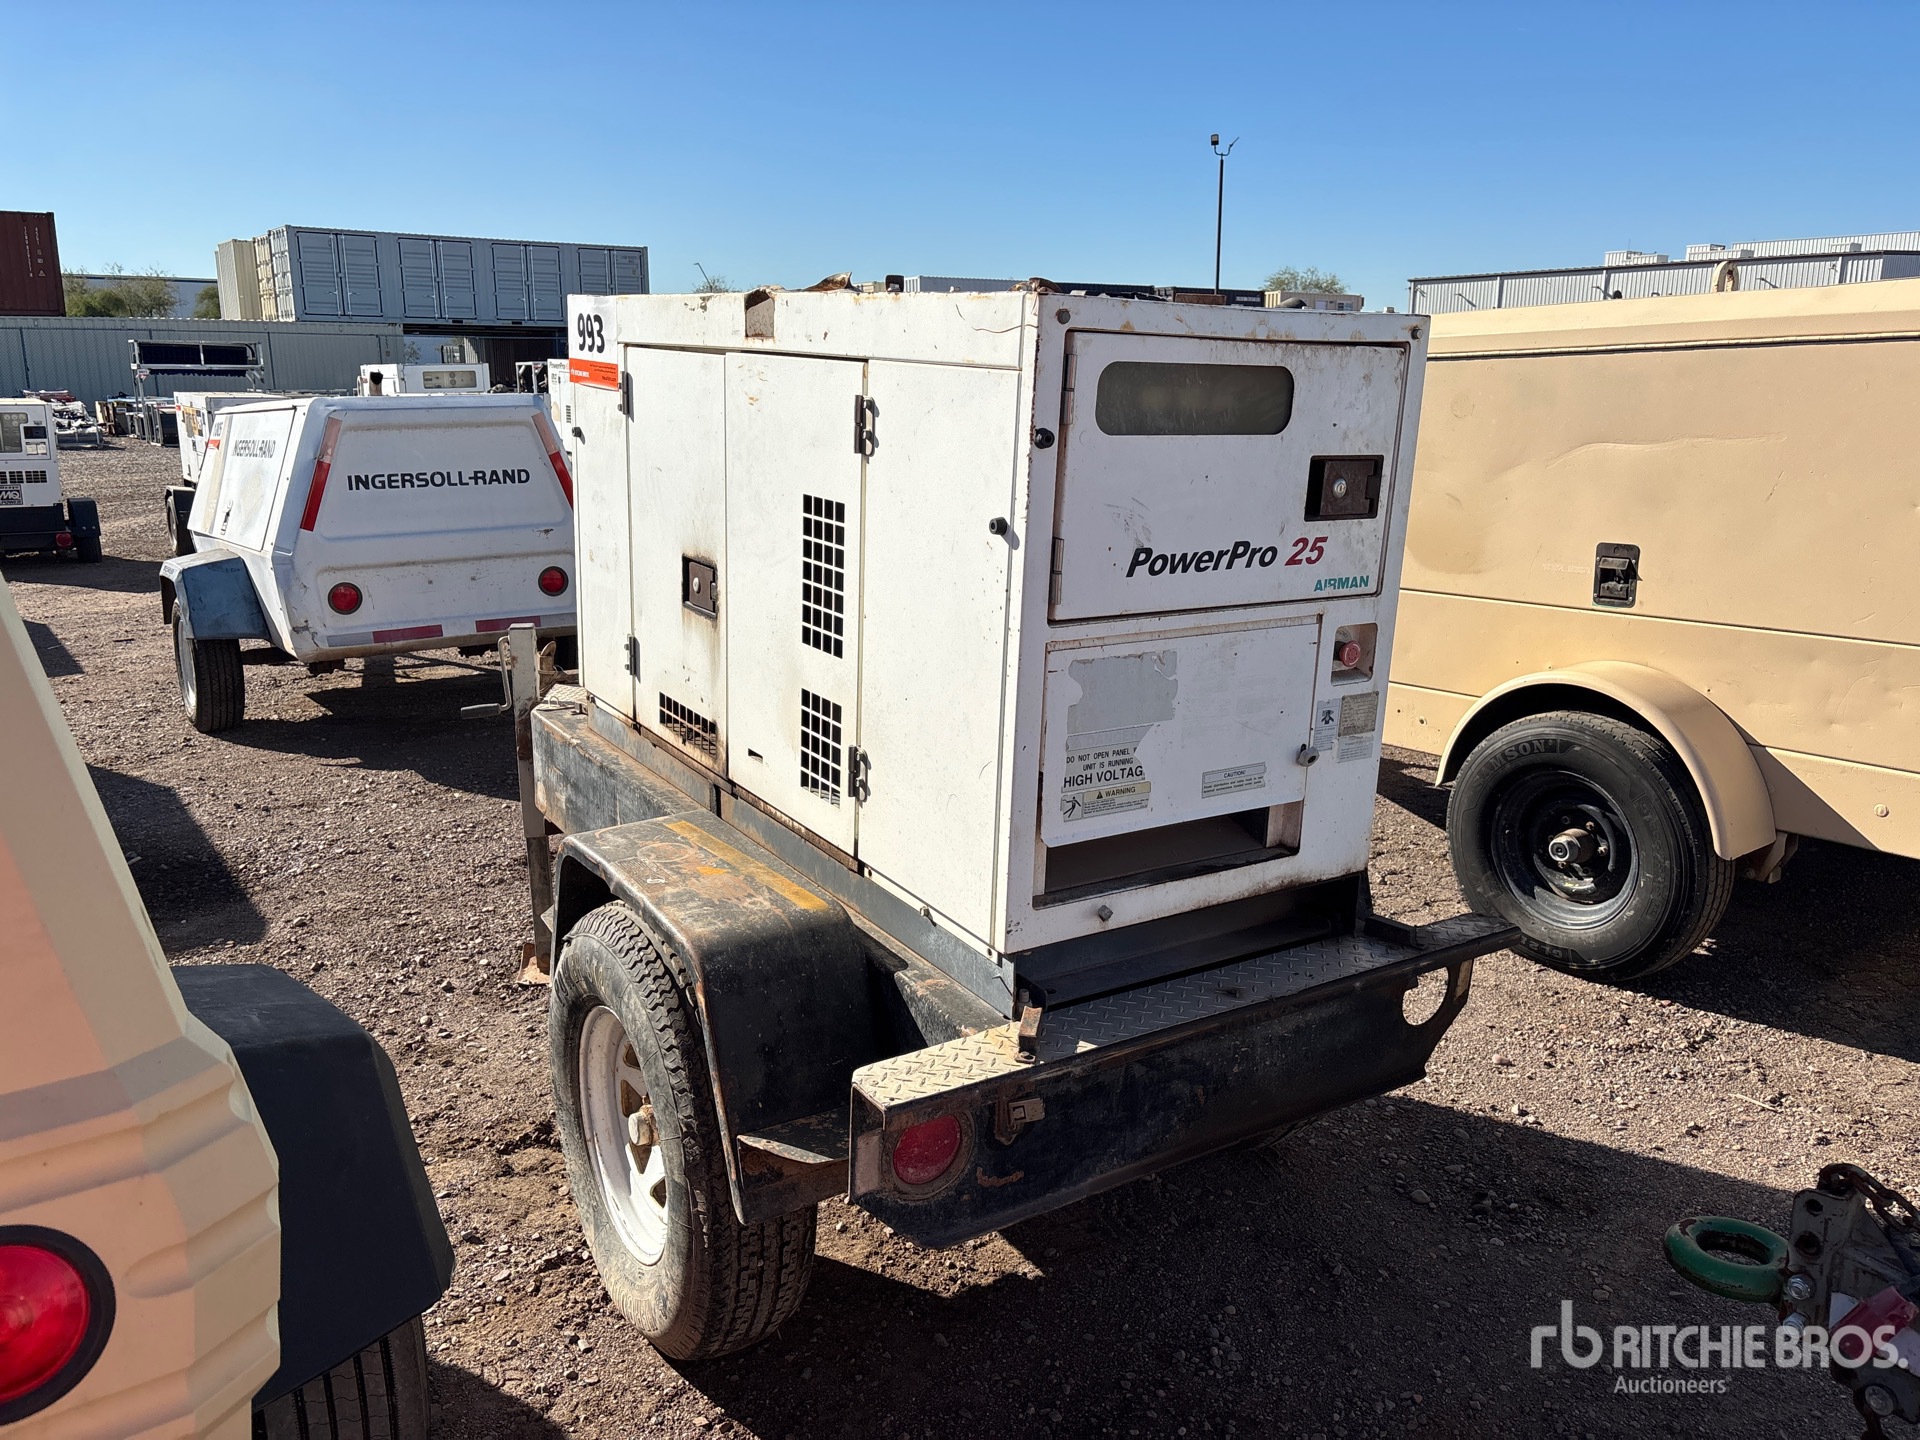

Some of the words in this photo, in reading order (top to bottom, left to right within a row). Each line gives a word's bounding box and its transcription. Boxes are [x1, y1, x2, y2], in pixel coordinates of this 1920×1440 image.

[577, 312, 605, 354] 993
[347, 467, 531, 491] INGERSOLL-RAND
[1125, 540, 1278, 577] PowerPro
[1284, 536, 1328, 566] 25
[1313, 575, 1370, 593] AIRMAN
[1066, 755, 1074, 763] DO
[1078, 753, 1090, 761] NOT
[1093, 750, 1108, 759] OPEN
[1112, 747, 1129, 756] PANEL
[1082, 762, 1095, 770] UNIT
[1107, 757, 1133, 767] RUNNING
[1472, 738, 1546, 789] SAMSON
[1063, 773, 1092, 787] HIGH
[1096, 765, 1144, 782] VOLTAG
[1105, 786, 1135, 797] WARNING
